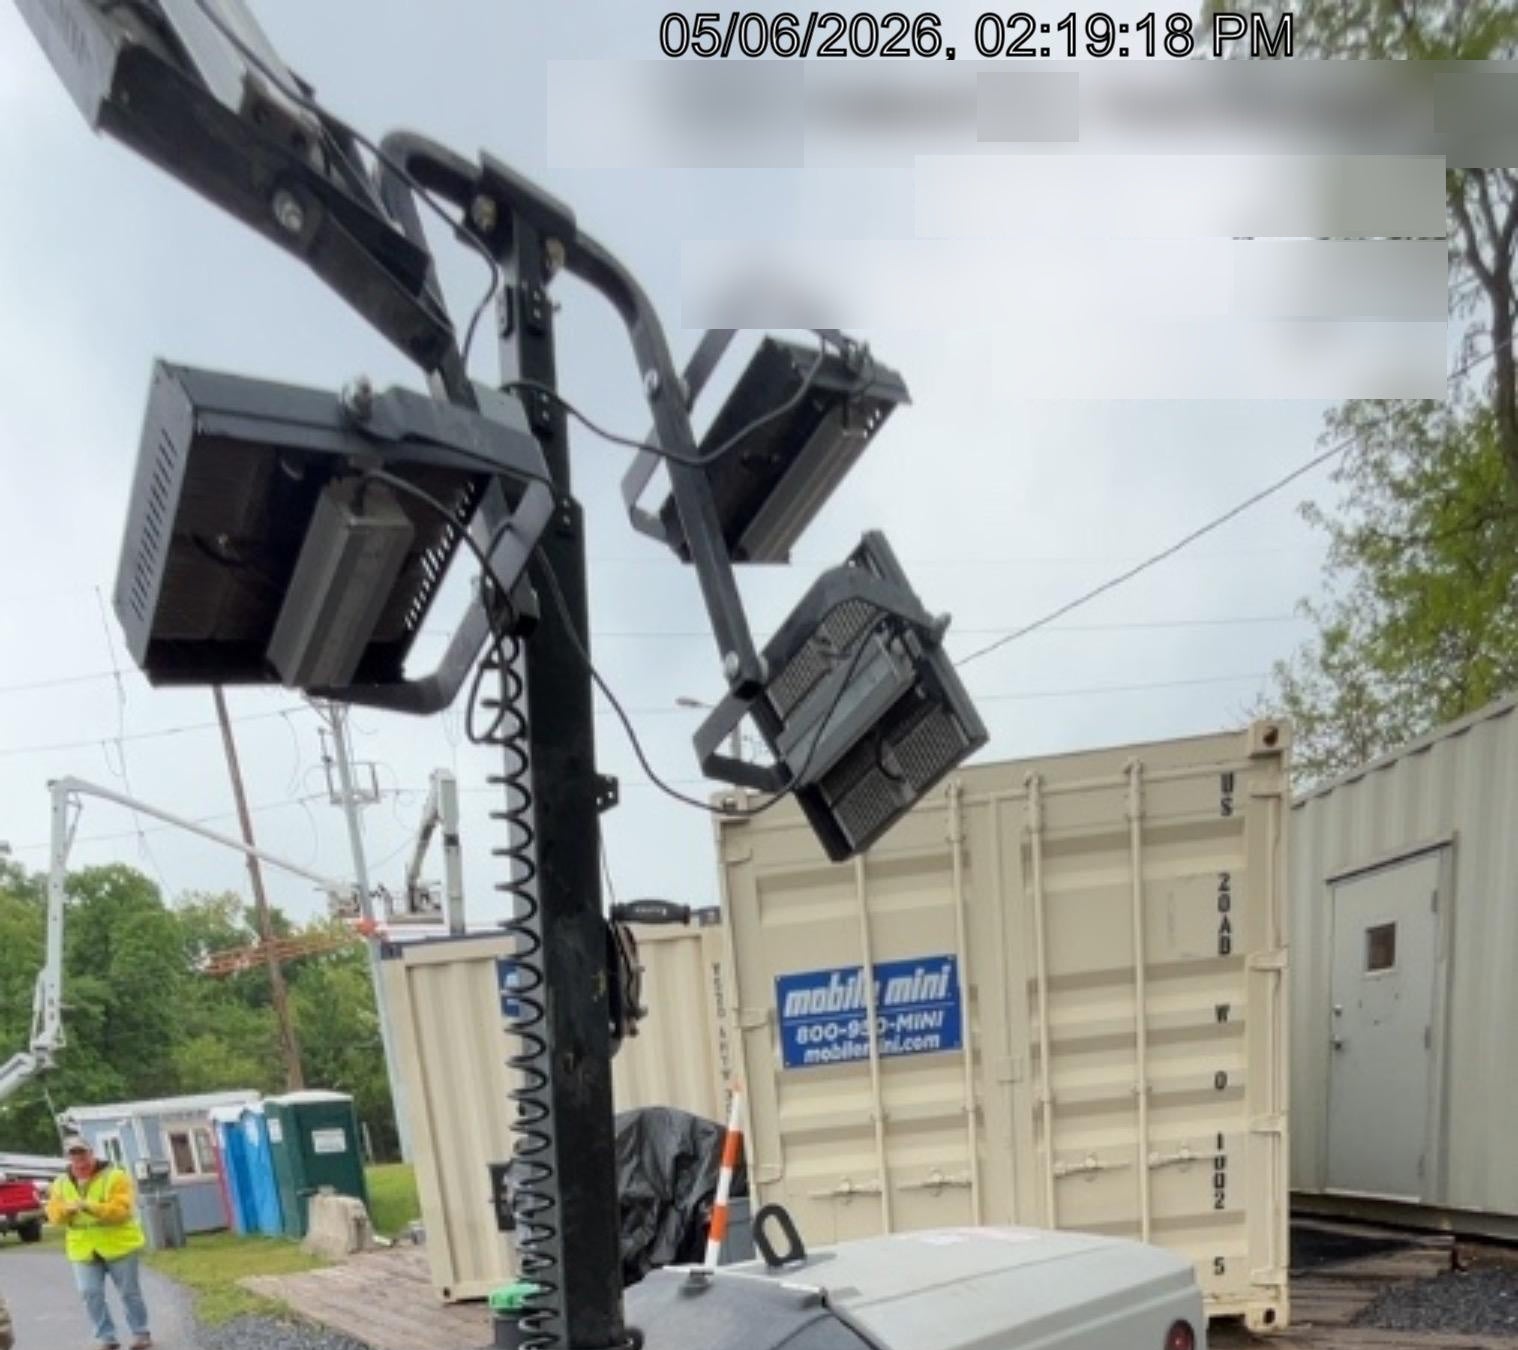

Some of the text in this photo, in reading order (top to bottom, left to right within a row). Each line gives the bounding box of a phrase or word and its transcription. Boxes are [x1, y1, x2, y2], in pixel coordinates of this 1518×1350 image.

[1220, 770, 1235, 817] US
[884, 965, 952, 1007] mini
[1213, 1256, 1226, 1277] 5
